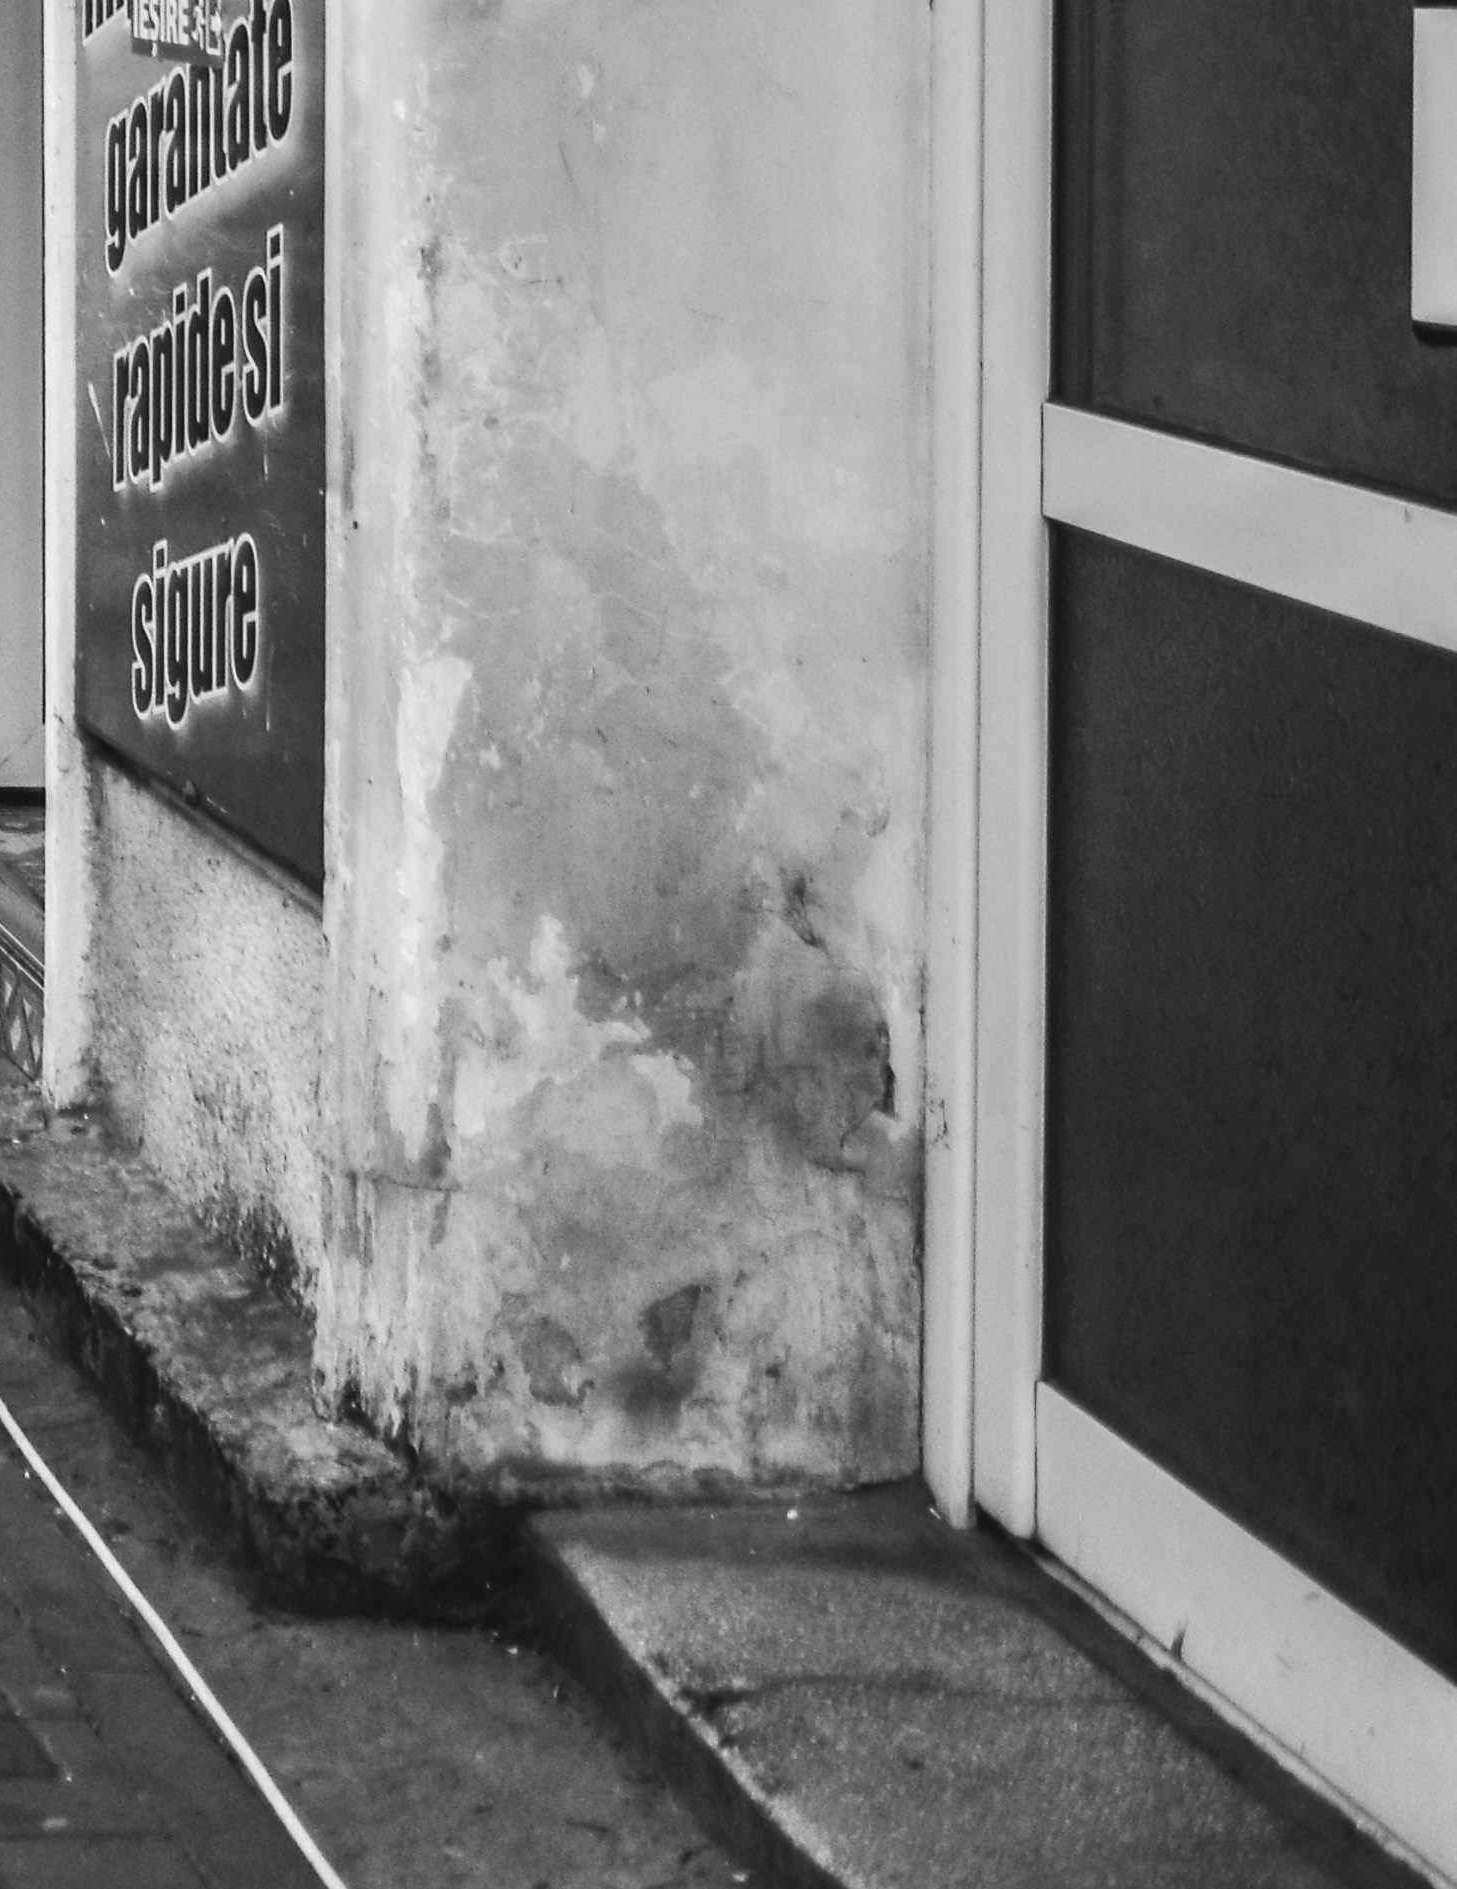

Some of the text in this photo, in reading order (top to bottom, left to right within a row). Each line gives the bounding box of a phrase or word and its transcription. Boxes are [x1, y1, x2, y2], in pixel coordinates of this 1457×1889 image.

[113, 222, 285, 493] rapide si
[130, 530, 261, 732] sigure
